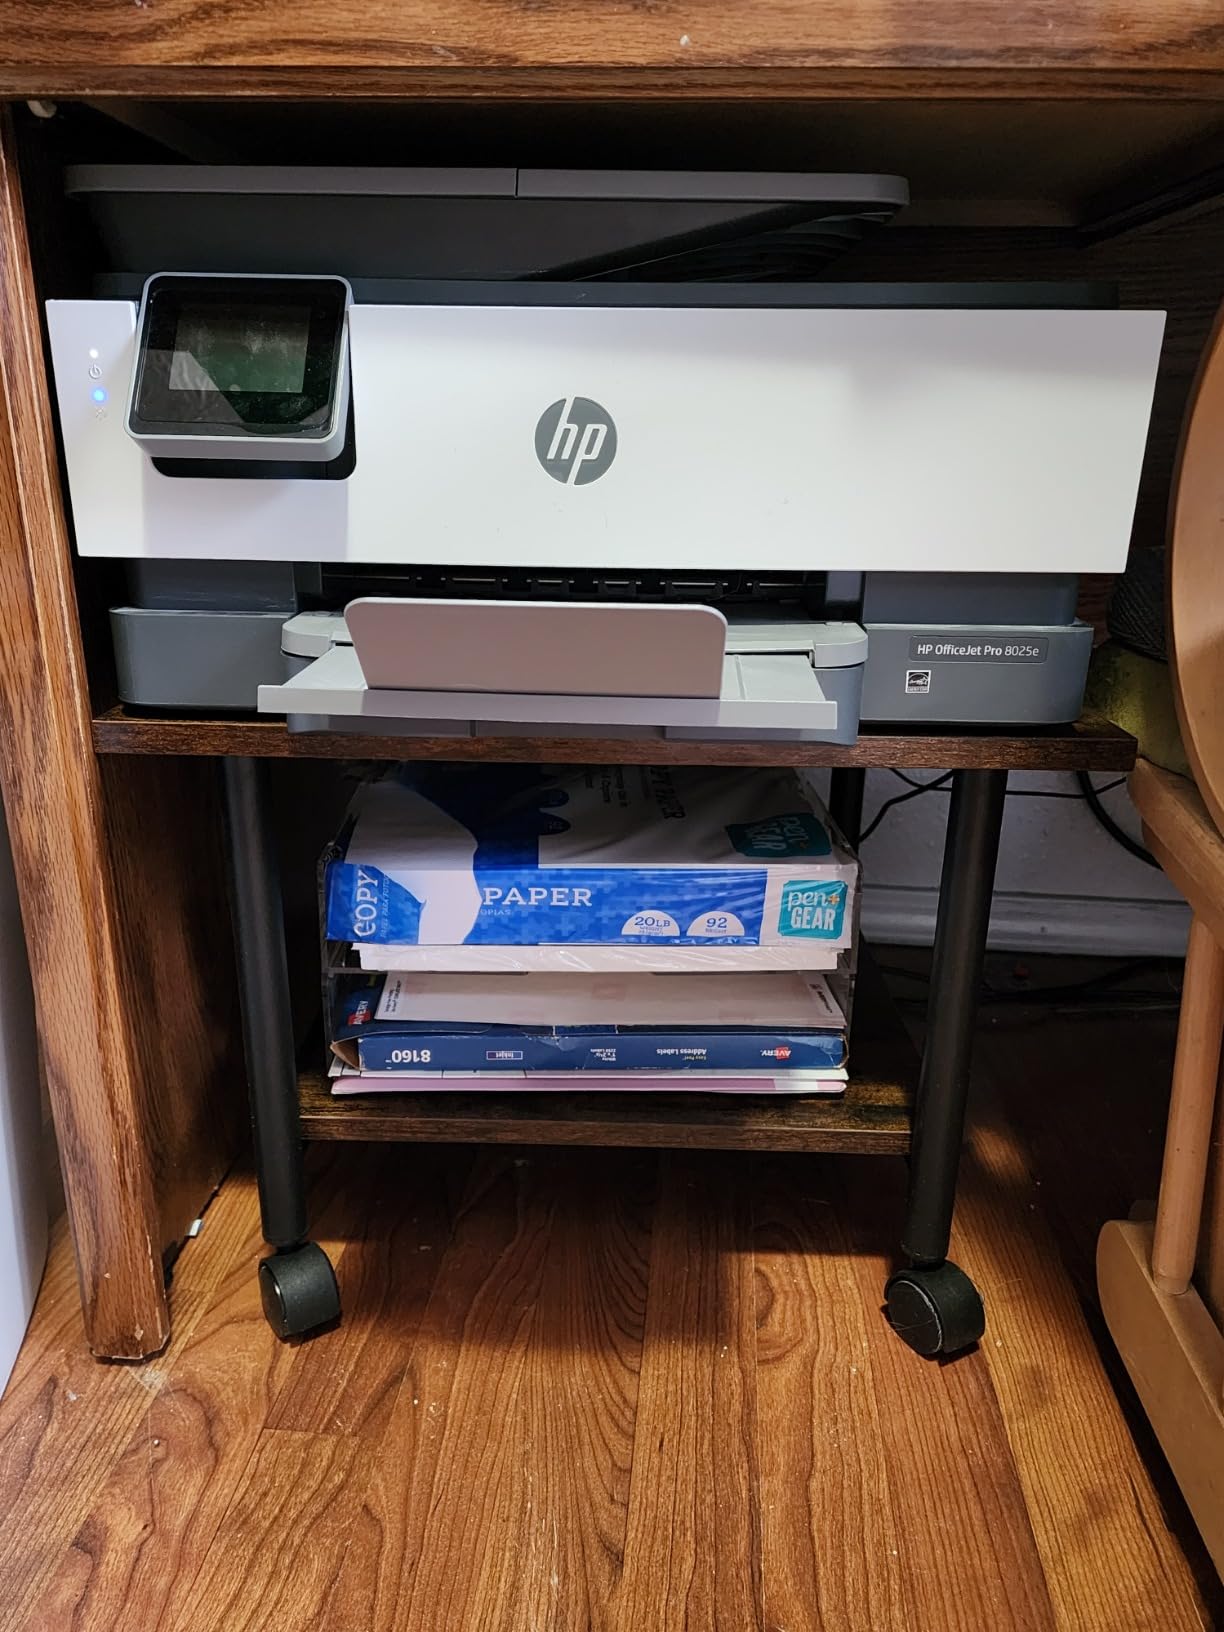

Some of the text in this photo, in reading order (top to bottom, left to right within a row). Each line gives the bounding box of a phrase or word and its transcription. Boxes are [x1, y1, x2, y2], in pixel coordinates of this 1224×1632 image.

[546, 396, 608, 486] hp
[917, 644, 1040, 657] HP OfficeJet Pro 8025e
[482, 887, 593, 907] PAPER
[634, 916, 671, 928] 20LB
[705, 917, 728, 929] 92
[790, 906, 836, 931] GEAR
[391, 1049, 431, 1063] 8160
[656, 1048, 708, 1056] Address Labels
[761, 1049, 791, 1057] AVERY
